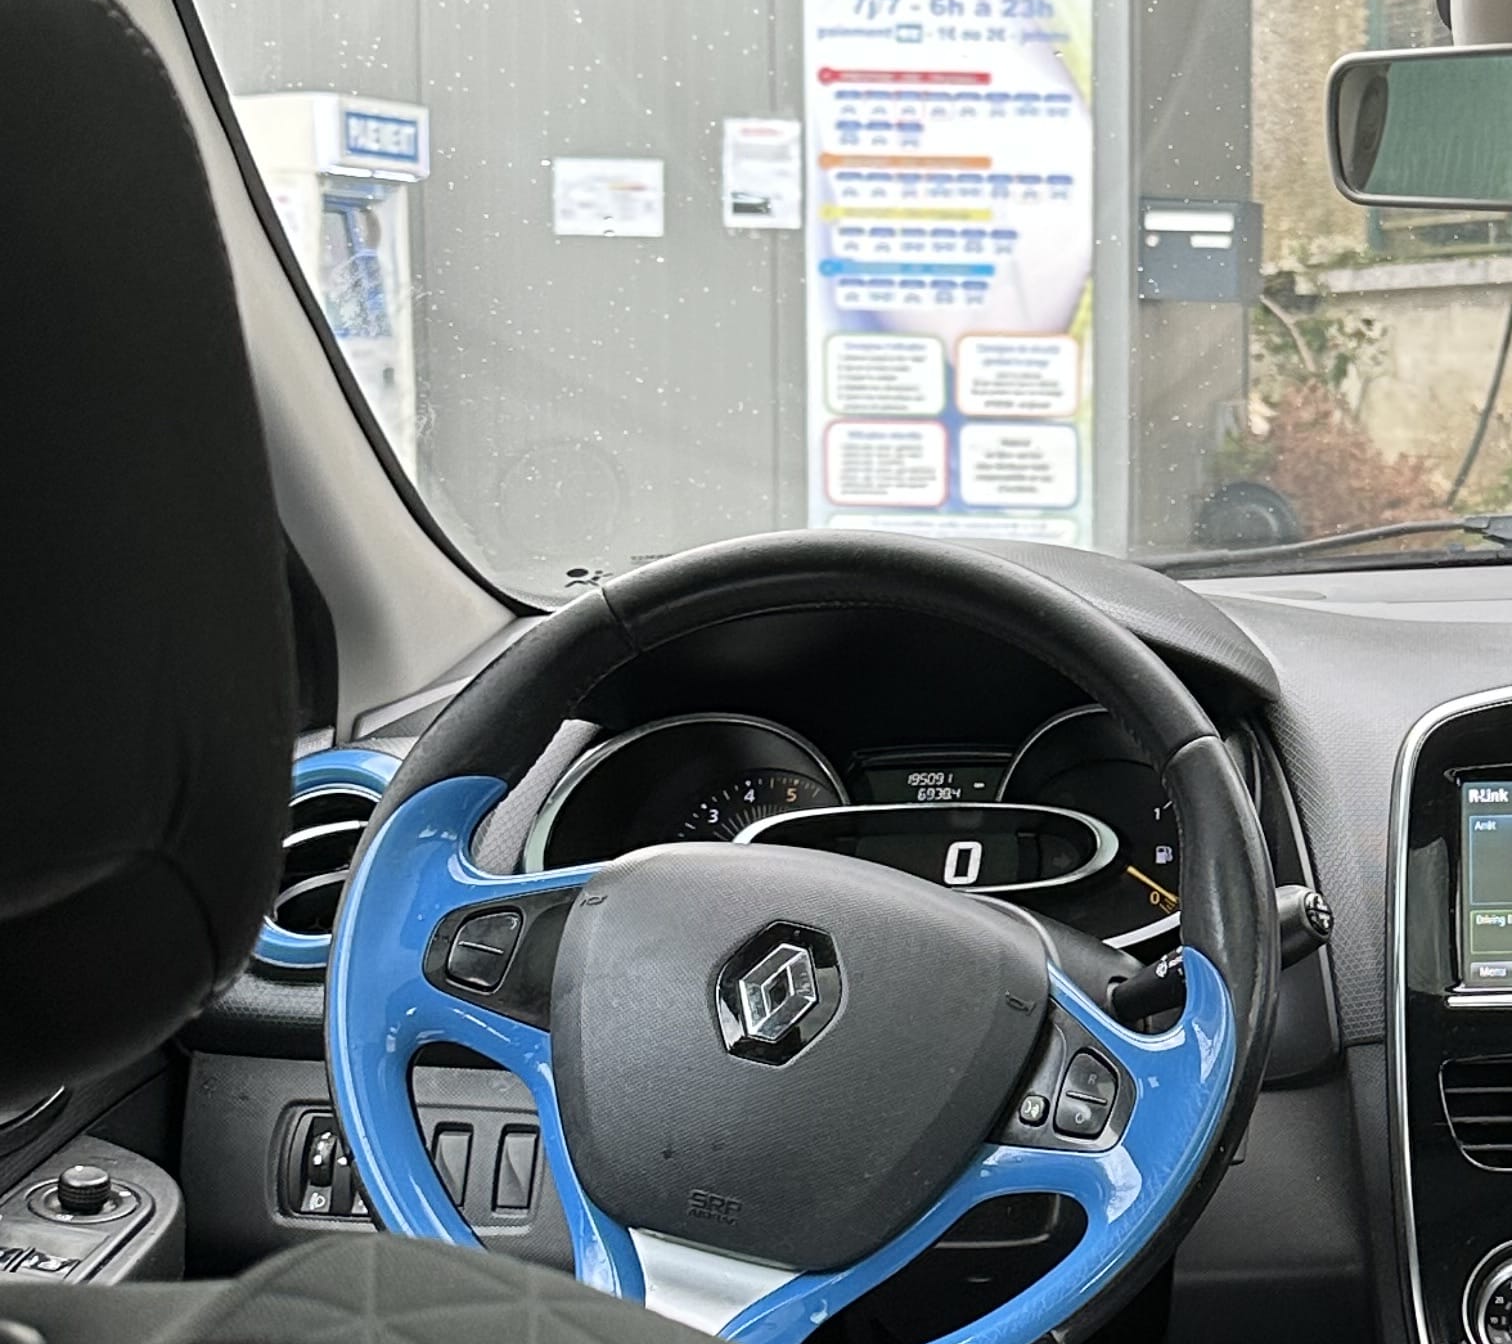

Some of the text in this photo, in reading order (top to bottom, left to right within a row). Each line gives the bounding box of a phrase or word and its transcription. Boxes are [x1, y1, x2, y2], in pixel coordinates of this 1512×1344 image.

[907, 772, 954, 786] 195091
[743, 789, 756, 803] 4
[786, 788, 797, 803] 5
[707, 810, 719, 824] 3
[1154, 807, 1161, 820] 1
[943, 841, 983, 885] 0
[1150, 891, 1160, 905] 0
[1479, 966, 1507, 977] Menu
[1088, 1074, 1098, 1085] R
